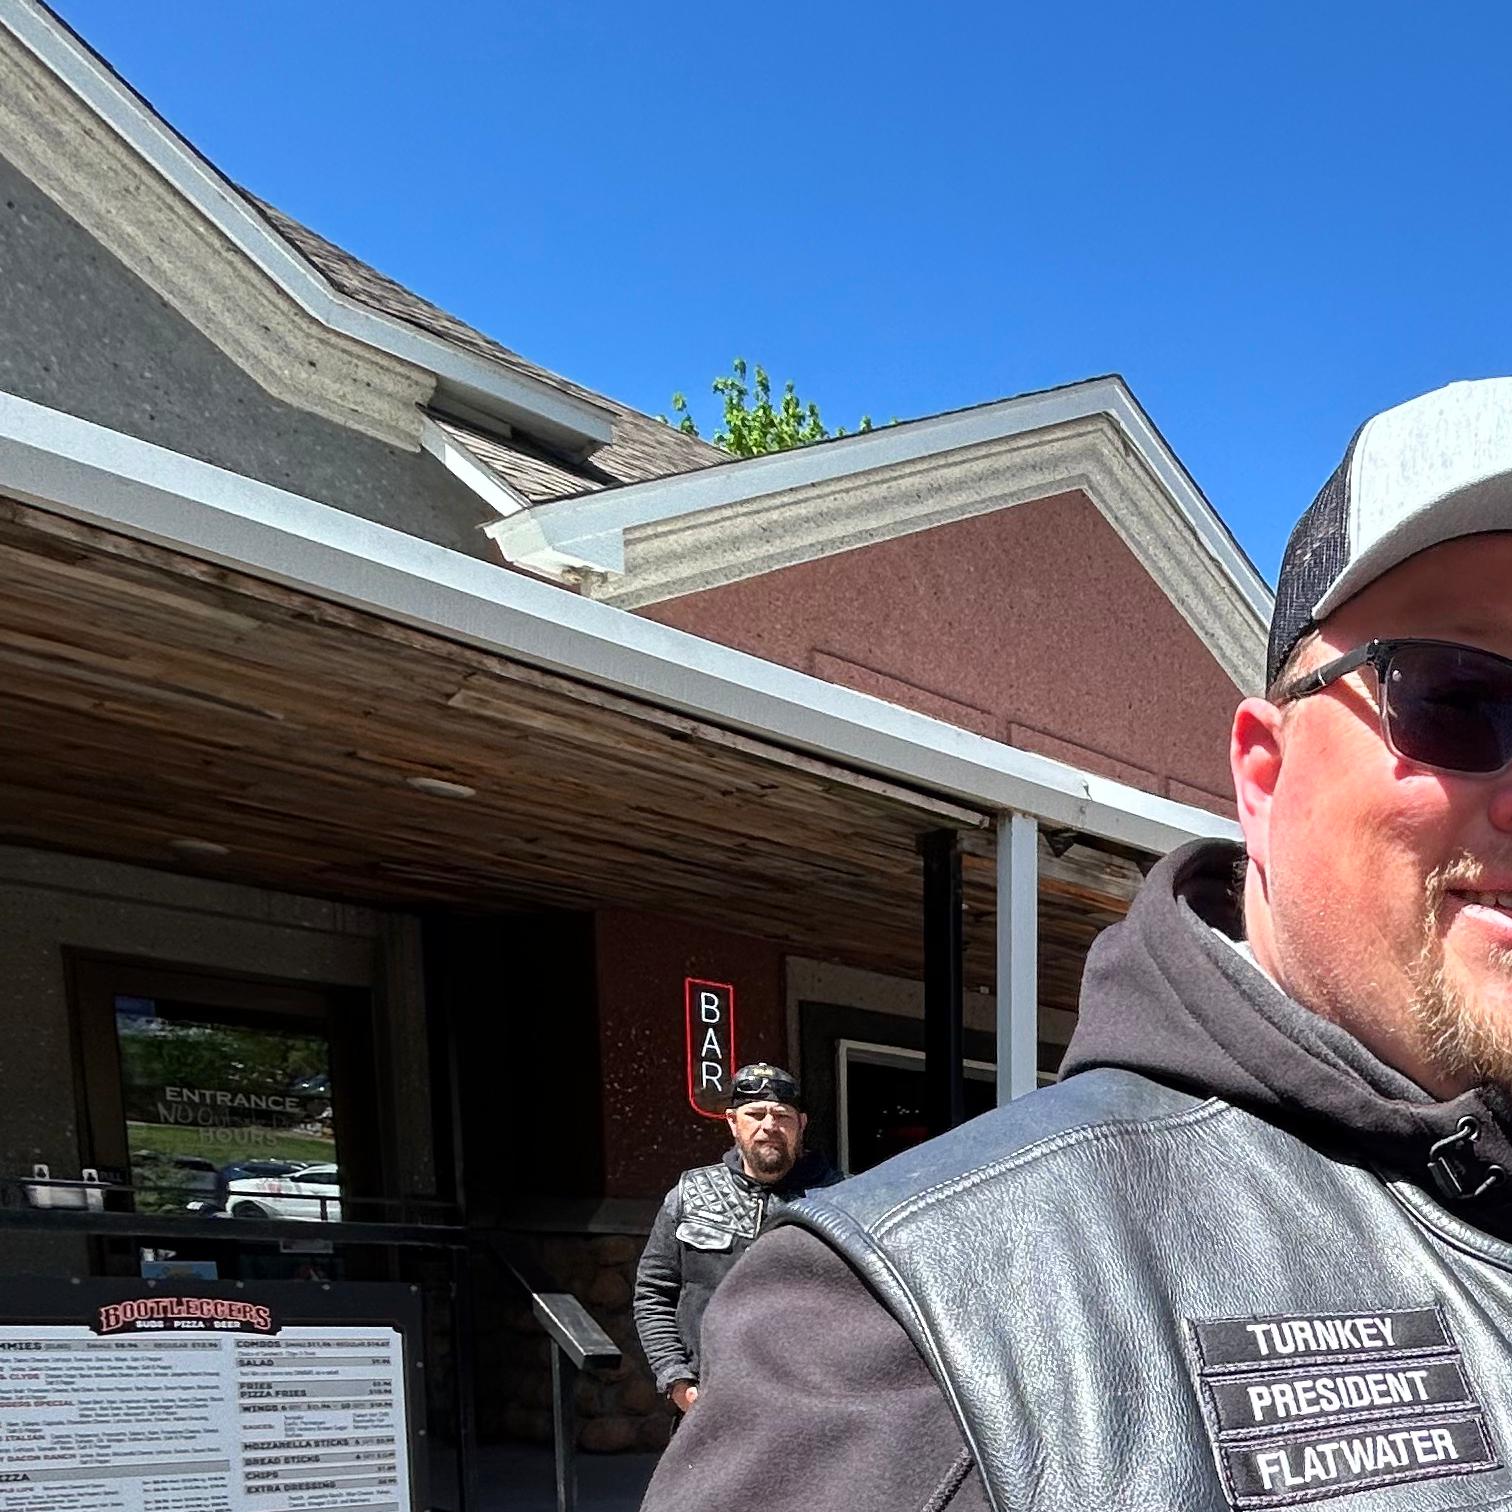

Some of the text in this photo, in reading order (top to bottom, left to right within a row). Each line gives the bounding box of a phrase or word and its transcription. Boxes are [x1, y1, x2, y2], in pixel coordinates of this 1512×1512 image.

[701, 992, 722, 1092] BAR
[165, 1086, 301, 1112] ENTRANCE
[200, 1126, 278, 1146] HOURS
[100, 1297, 272, 1332] BOOTLEGGERS
[173, 1320, 205, 1328] PIZZA
[1246, 1317, 1396, 1356] TURNKEY
[238, 1358, 274, 1366] SALAD
[240, 1390, 273, 1398] PIZZA
[275, 1389, 307, 1397] FRIES
[1247, 1370, 1429, 1422] PRESIDENT
[244, 1440, 312, 1451] MOZZARELLA
[1256, 1428, 1459, 1491] FLATWATER
[245, 1470, 279, 1479] CHIPS
[246, 1484, 281, 1494] EXTRA
[283, 1481, 336, 1492] DRESSING
